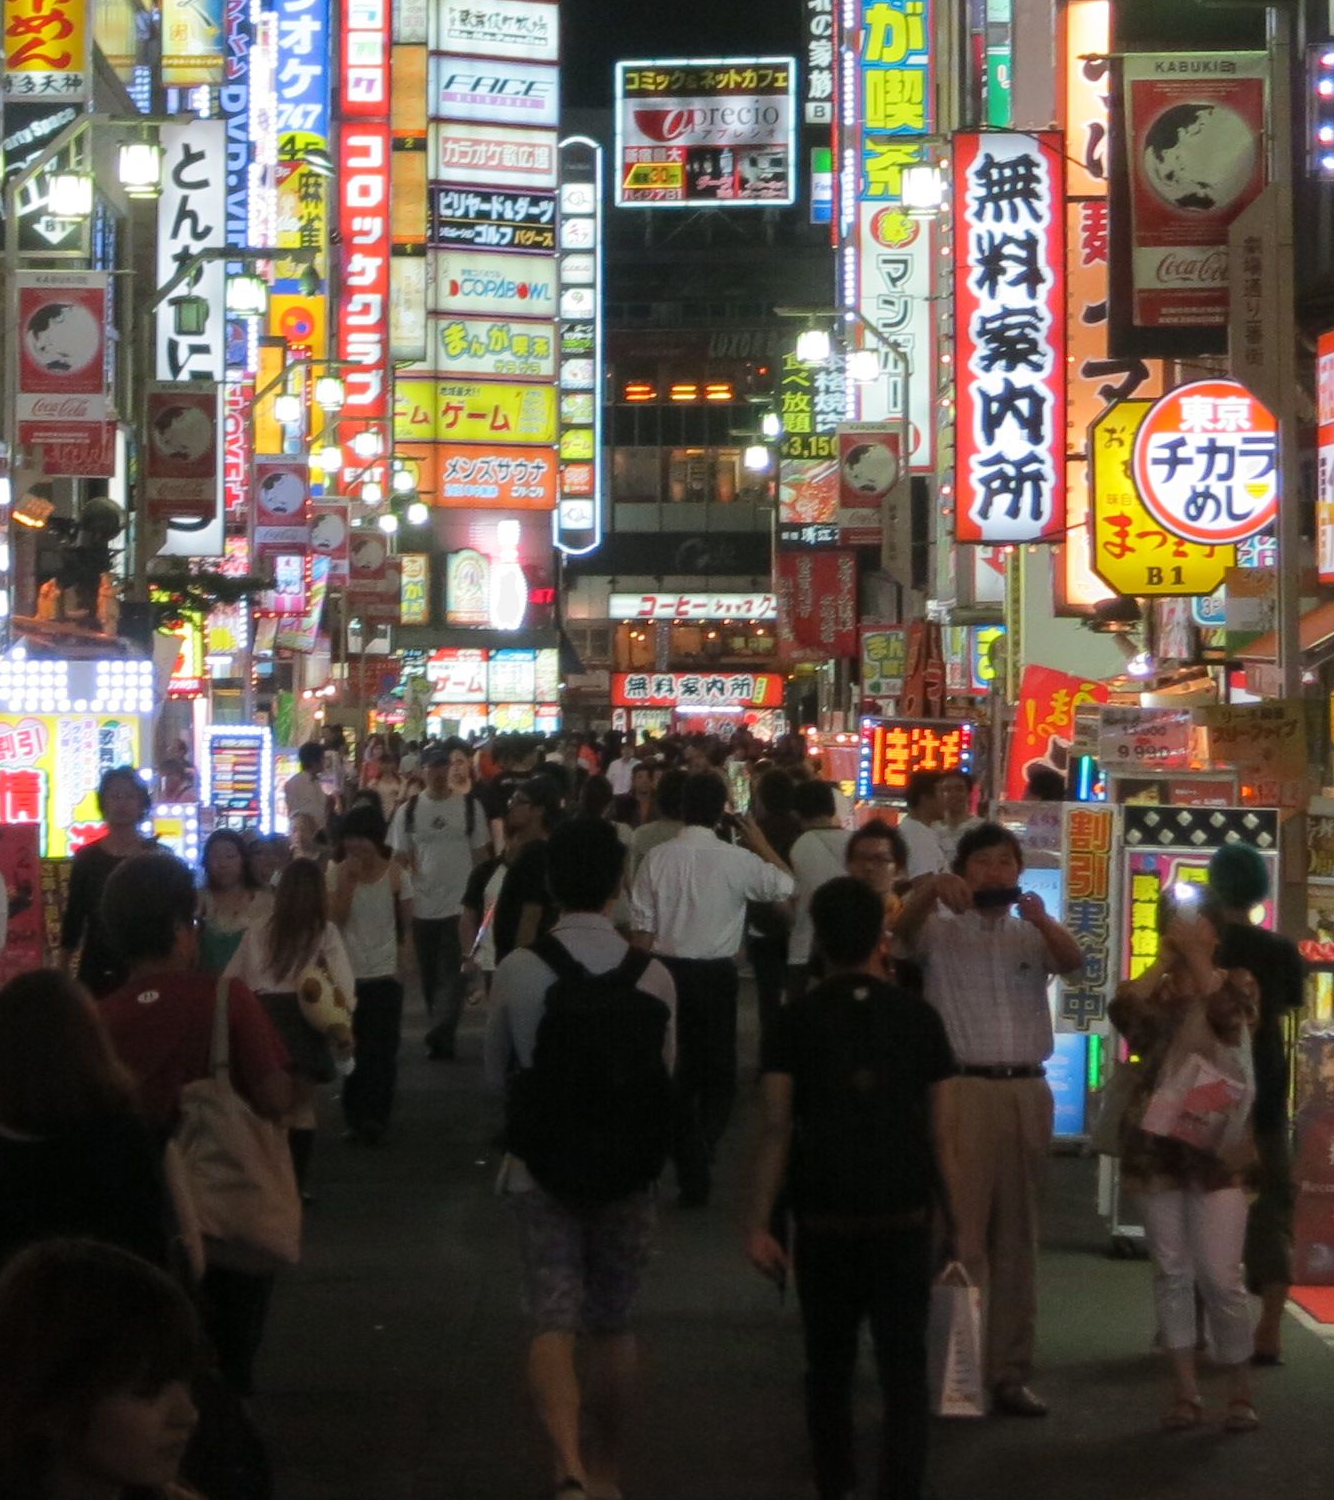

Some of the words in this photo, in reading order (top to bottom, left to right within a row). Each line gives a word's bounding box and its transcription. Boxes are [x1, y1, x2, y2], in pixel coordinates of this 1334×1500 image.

[442, 74, 554, 97] FACE
[277, 103, 324, 131] 747
[662, 101, 780, 140] aprecio
[443, 139, 552, 170] カラオケ歌広場
[474, 225, 514, 245] ゴルフ
[514, 228, 554, 246] バグース
[346, 135, 384, 406] コロッケクラブ
[1244, 235, 1264, 367] 劇場通り一番街
[442, 322, 551, 360] まんが喫茶
[973, 152, 1048, 522] 無料案内所
[442, 401, 510, 432] ゲーム
[1179, 396, 1252, 431] 東京
[444, 458, 547, 483] メンズサウナ
[1151, 436, 1279, 484] チカラ
[1184, 485, 1256, 523] めし
[639, 596, 707, 617] コーヒー
[624, 674, 754, 698] 無料案内所
